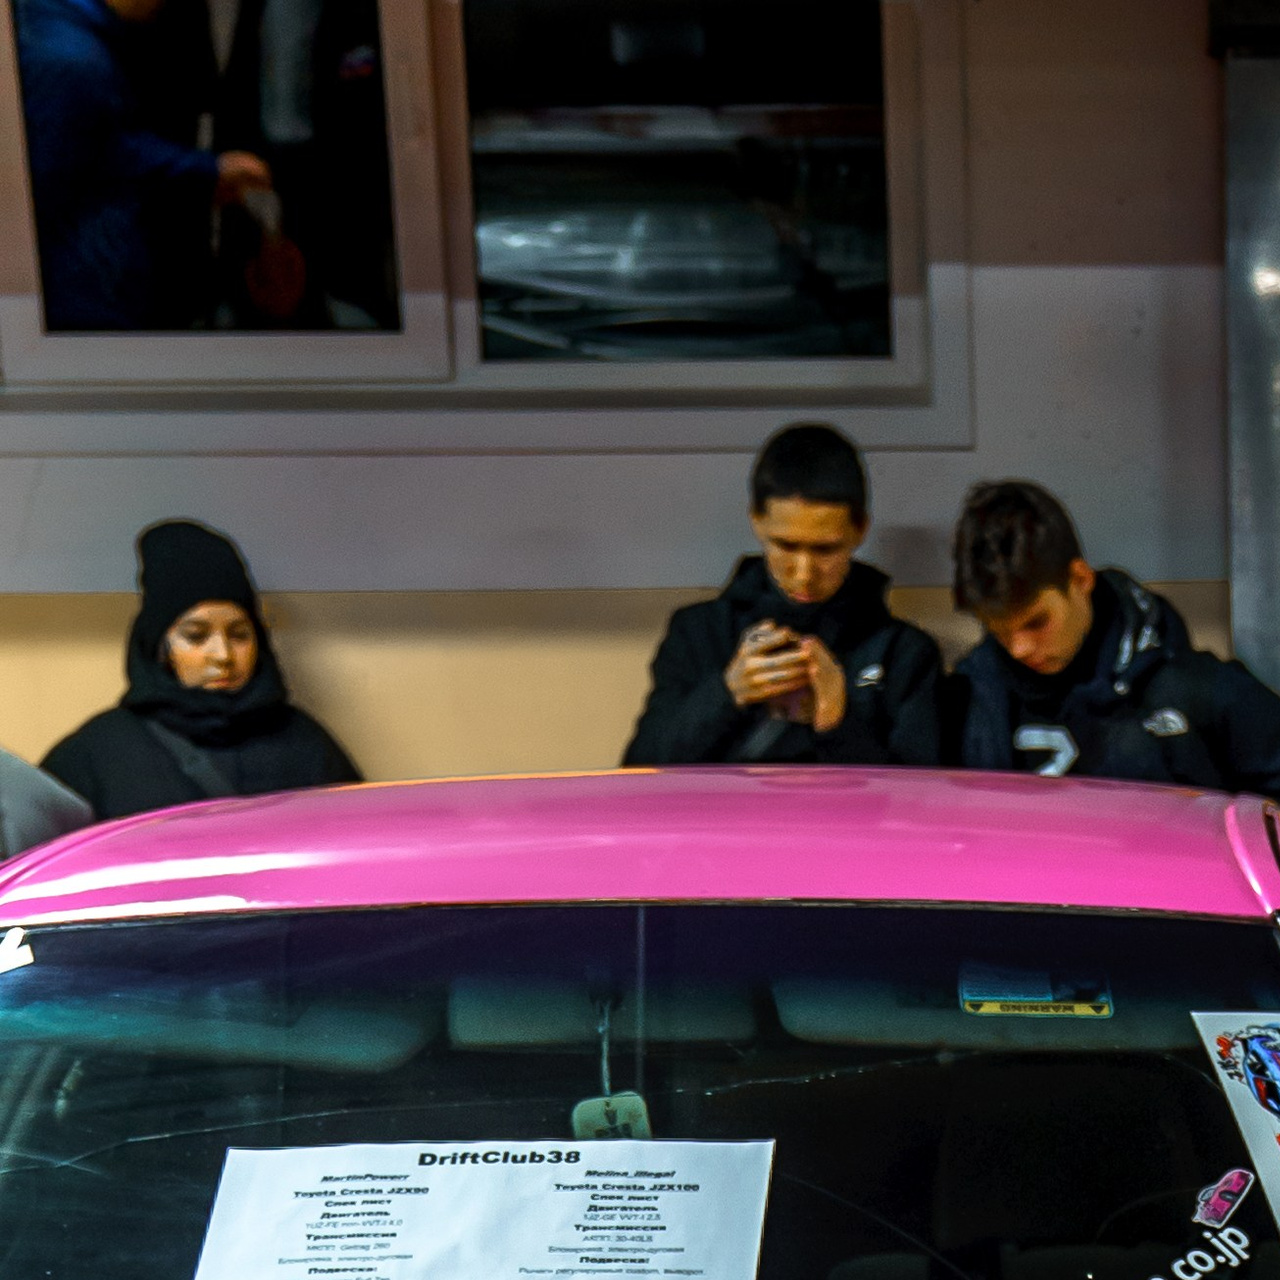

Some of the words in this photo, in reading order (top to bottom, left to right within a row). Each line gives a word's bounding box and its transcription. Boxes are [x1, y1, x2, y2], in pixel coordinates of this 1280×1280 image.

[418, 1150, 581, 1166] DriftClub38
[293, 1188, 336, 1199] Toyota
[341, 1187, 383, 1196] Cresta
[555, 1183, 598, 1191] Toyota
[602, 1183, 645, 1191] Cresta
